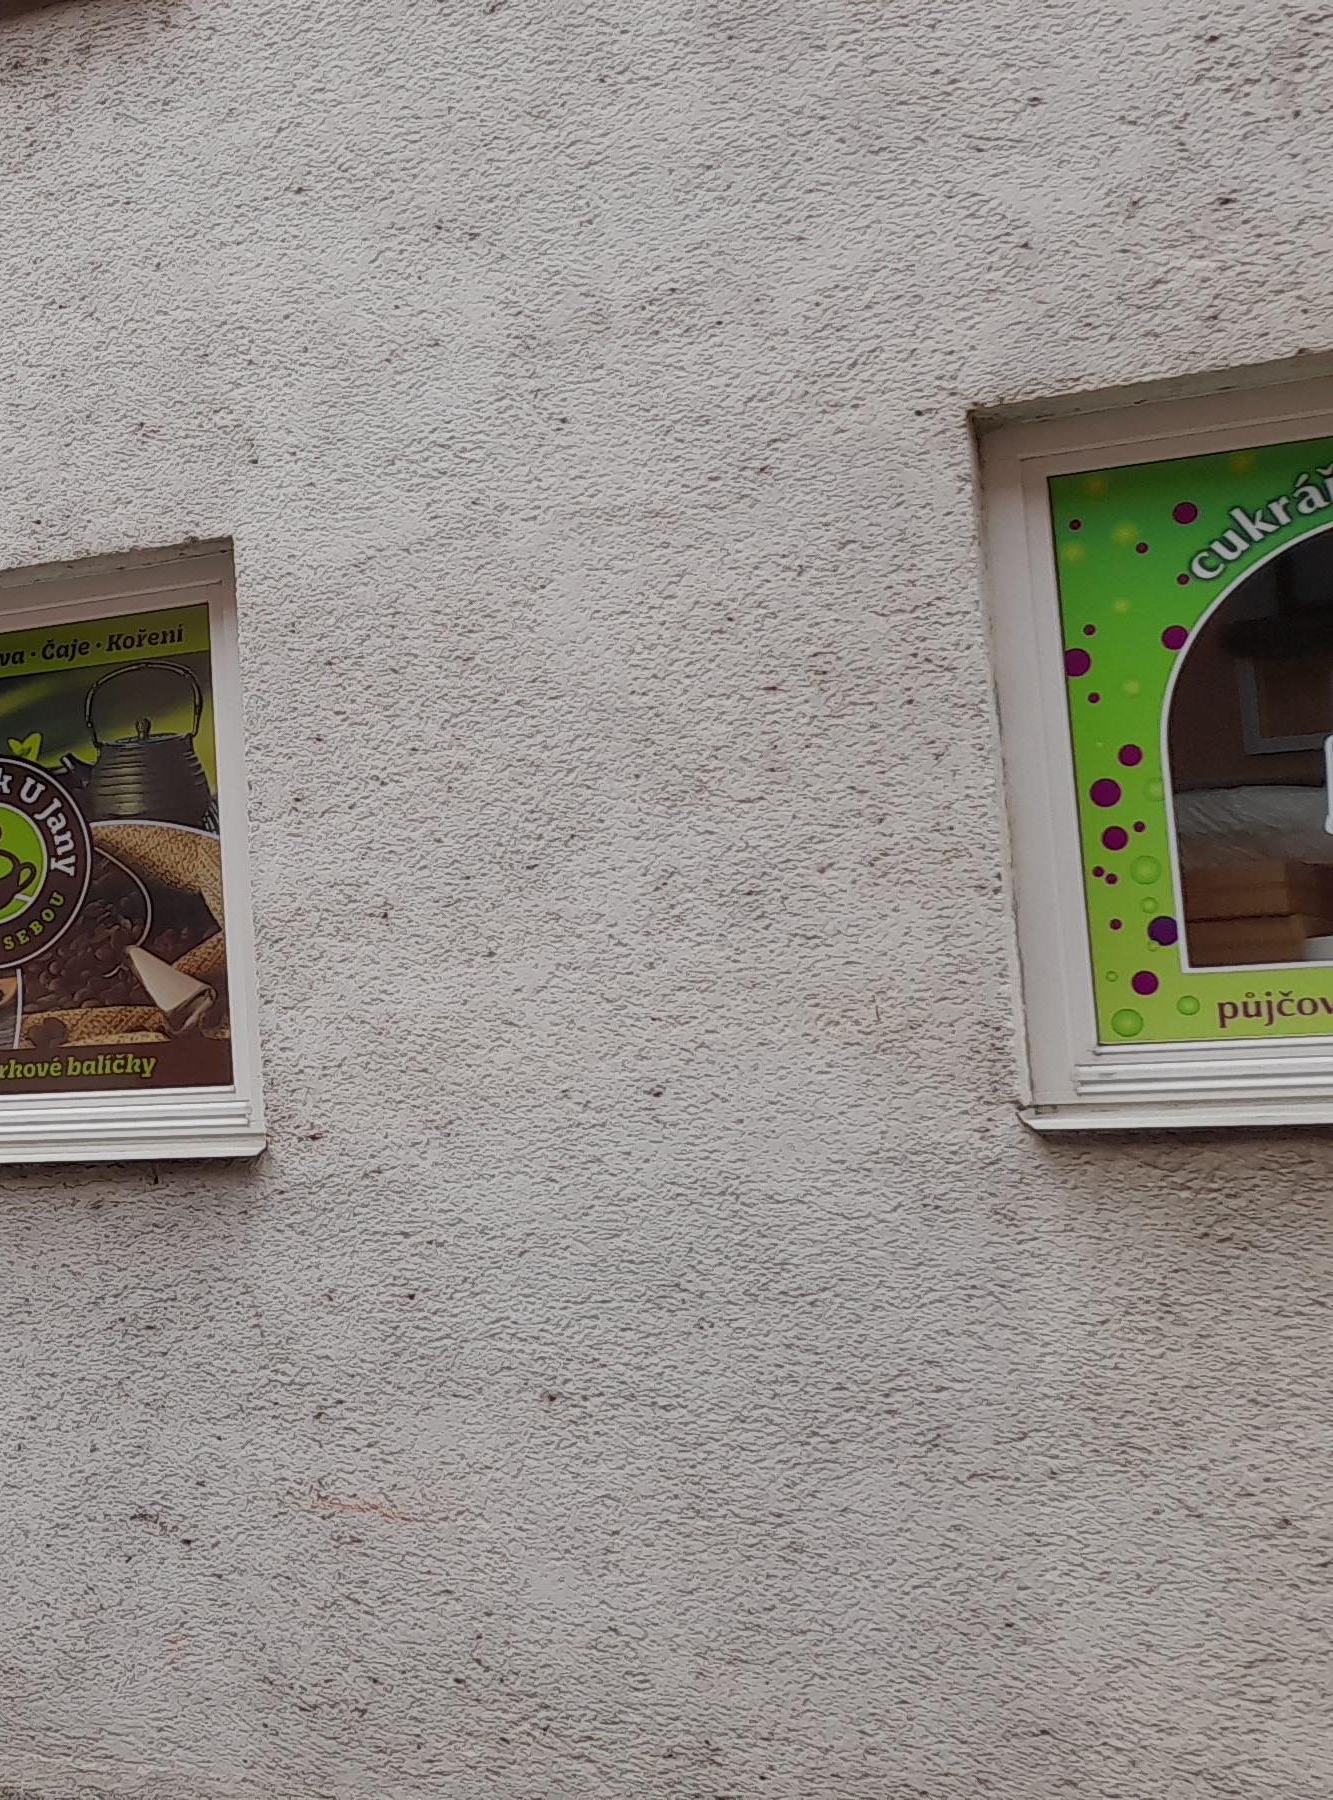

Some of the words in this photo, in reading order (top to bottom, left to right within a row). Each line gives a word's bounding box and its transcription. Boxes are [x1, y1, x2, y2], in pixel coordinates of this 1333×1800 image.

[41, 639, 91, 662] Čaje
[20, 777, 46, 804] U
[33, 798, 76, 877] Jany
[3, 892, 65, 950] SEBOU
[66, 1053, 157, 1078] balíčky
